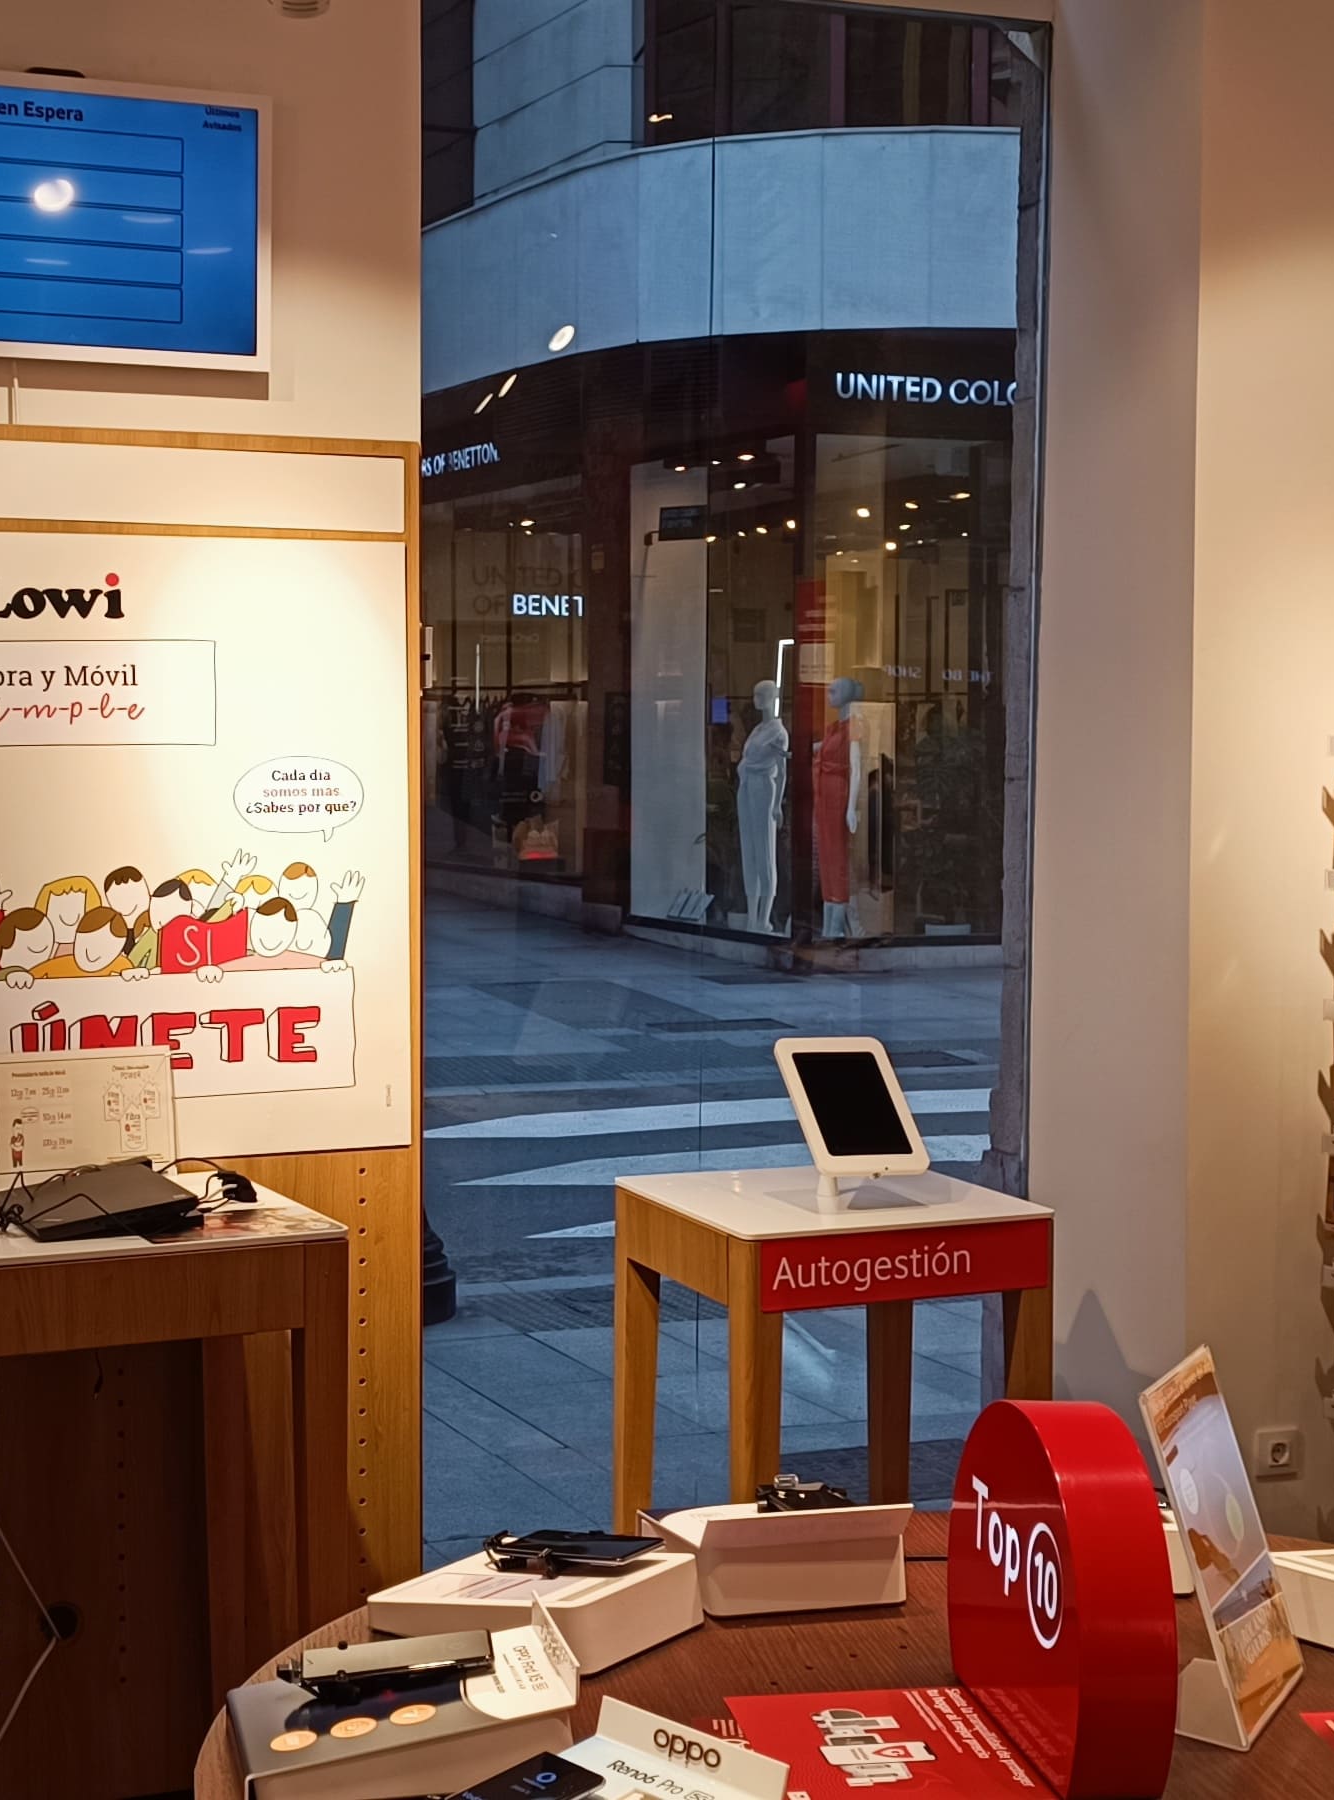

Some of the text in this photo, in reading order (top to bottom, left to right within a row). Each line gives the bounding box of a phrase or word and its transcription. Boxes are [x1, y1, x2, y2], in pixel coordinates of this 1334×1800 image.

[23, 100, 84, 122] Espera
[836, 372, 943, 403] UNITED
[42, 670, 56, 692] y
[64, 664, 139, 687] Móvil
[271, 769, 306, 782] Cada
[262, 787, 308, 798] somos
[245, 801, 295, 814] ¿Sabes
[298, 802, 321, 816] por
[772, 1241, 971, 1292] Autogestión
[972, 1474, 1058, 1620] Top 10
[606, 1759, 660, 1785] Reno6
[656, 1778, 684, 1796] Pro
